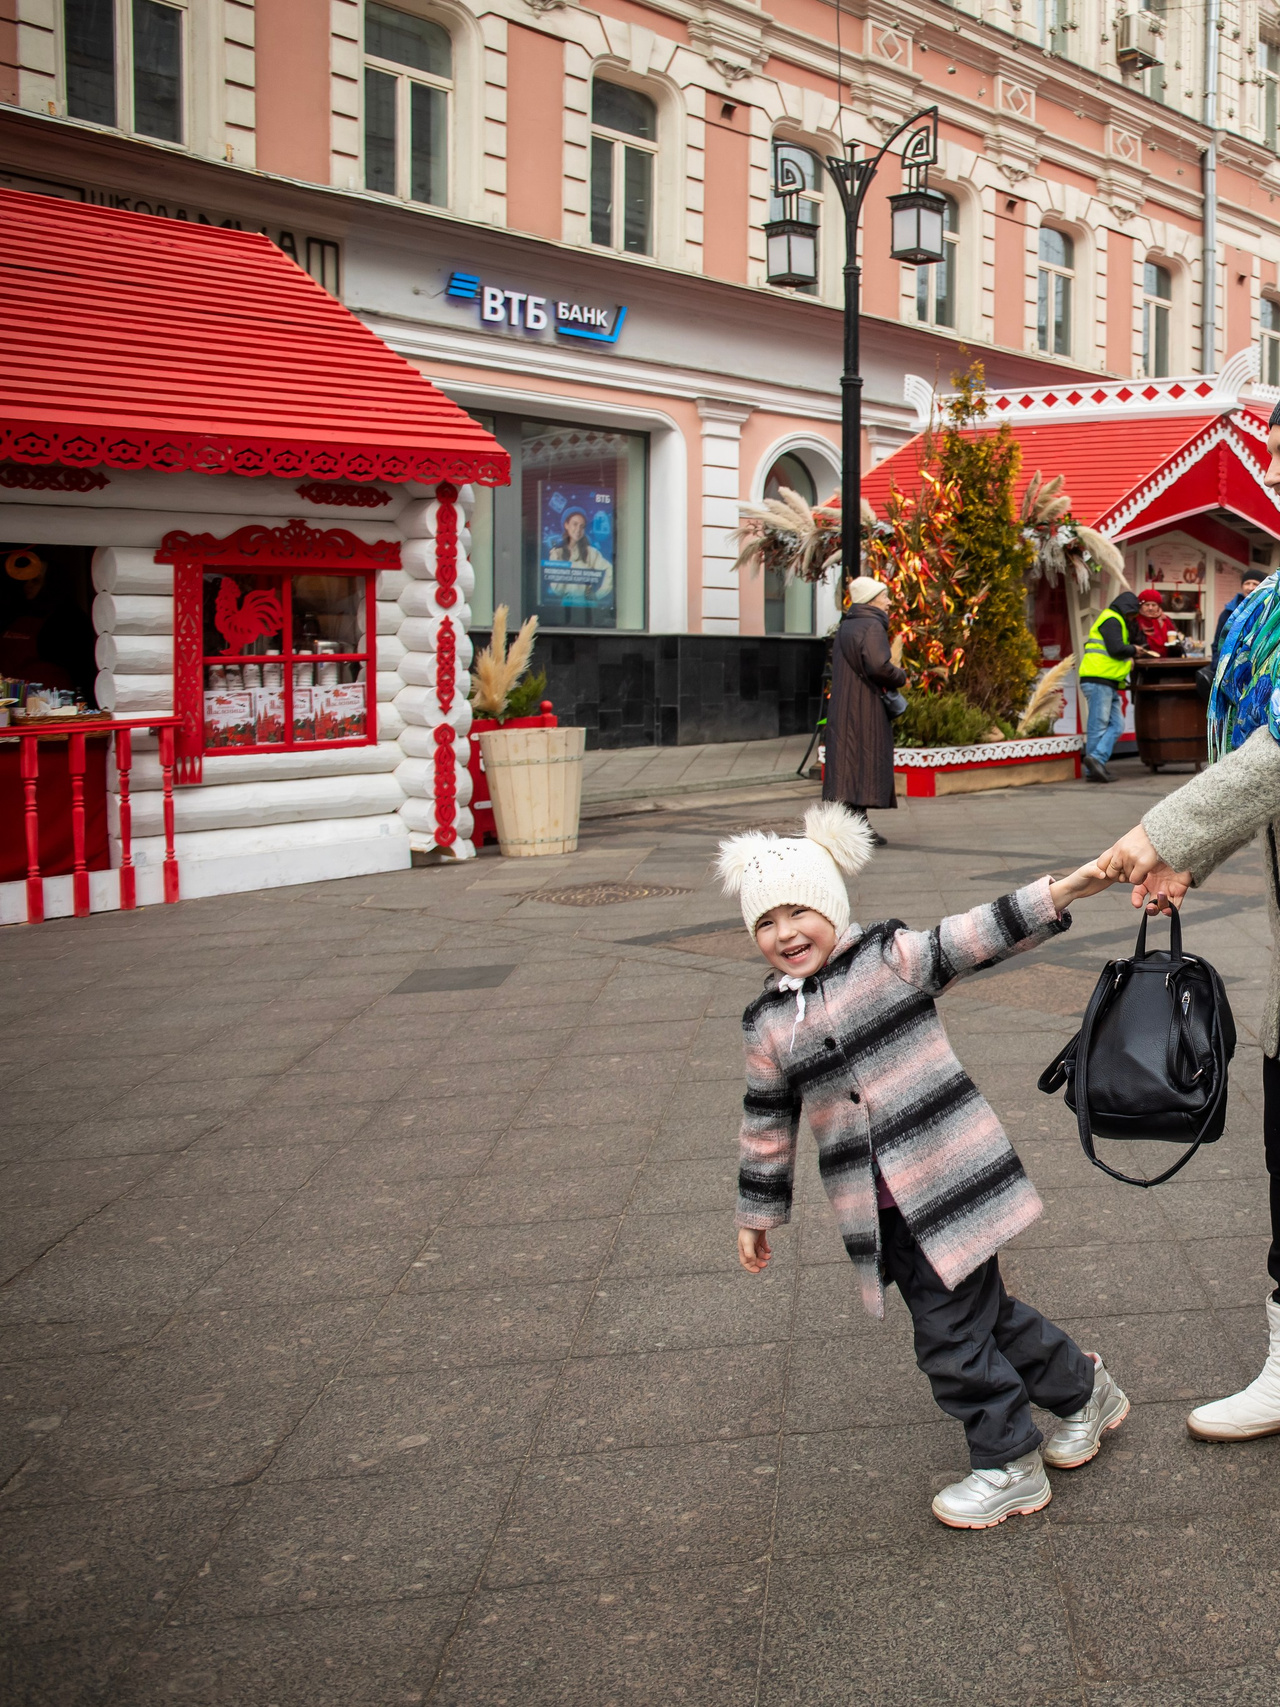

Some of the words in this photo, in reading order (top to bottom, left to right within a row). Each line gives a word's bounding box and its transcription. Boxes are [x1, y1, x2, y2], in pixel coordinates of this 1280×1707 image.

[482, 286, 548, 330] ВТБ
[557, 302, 608, 328] БАНК
[595, 493, 611, 504] ВТБ
